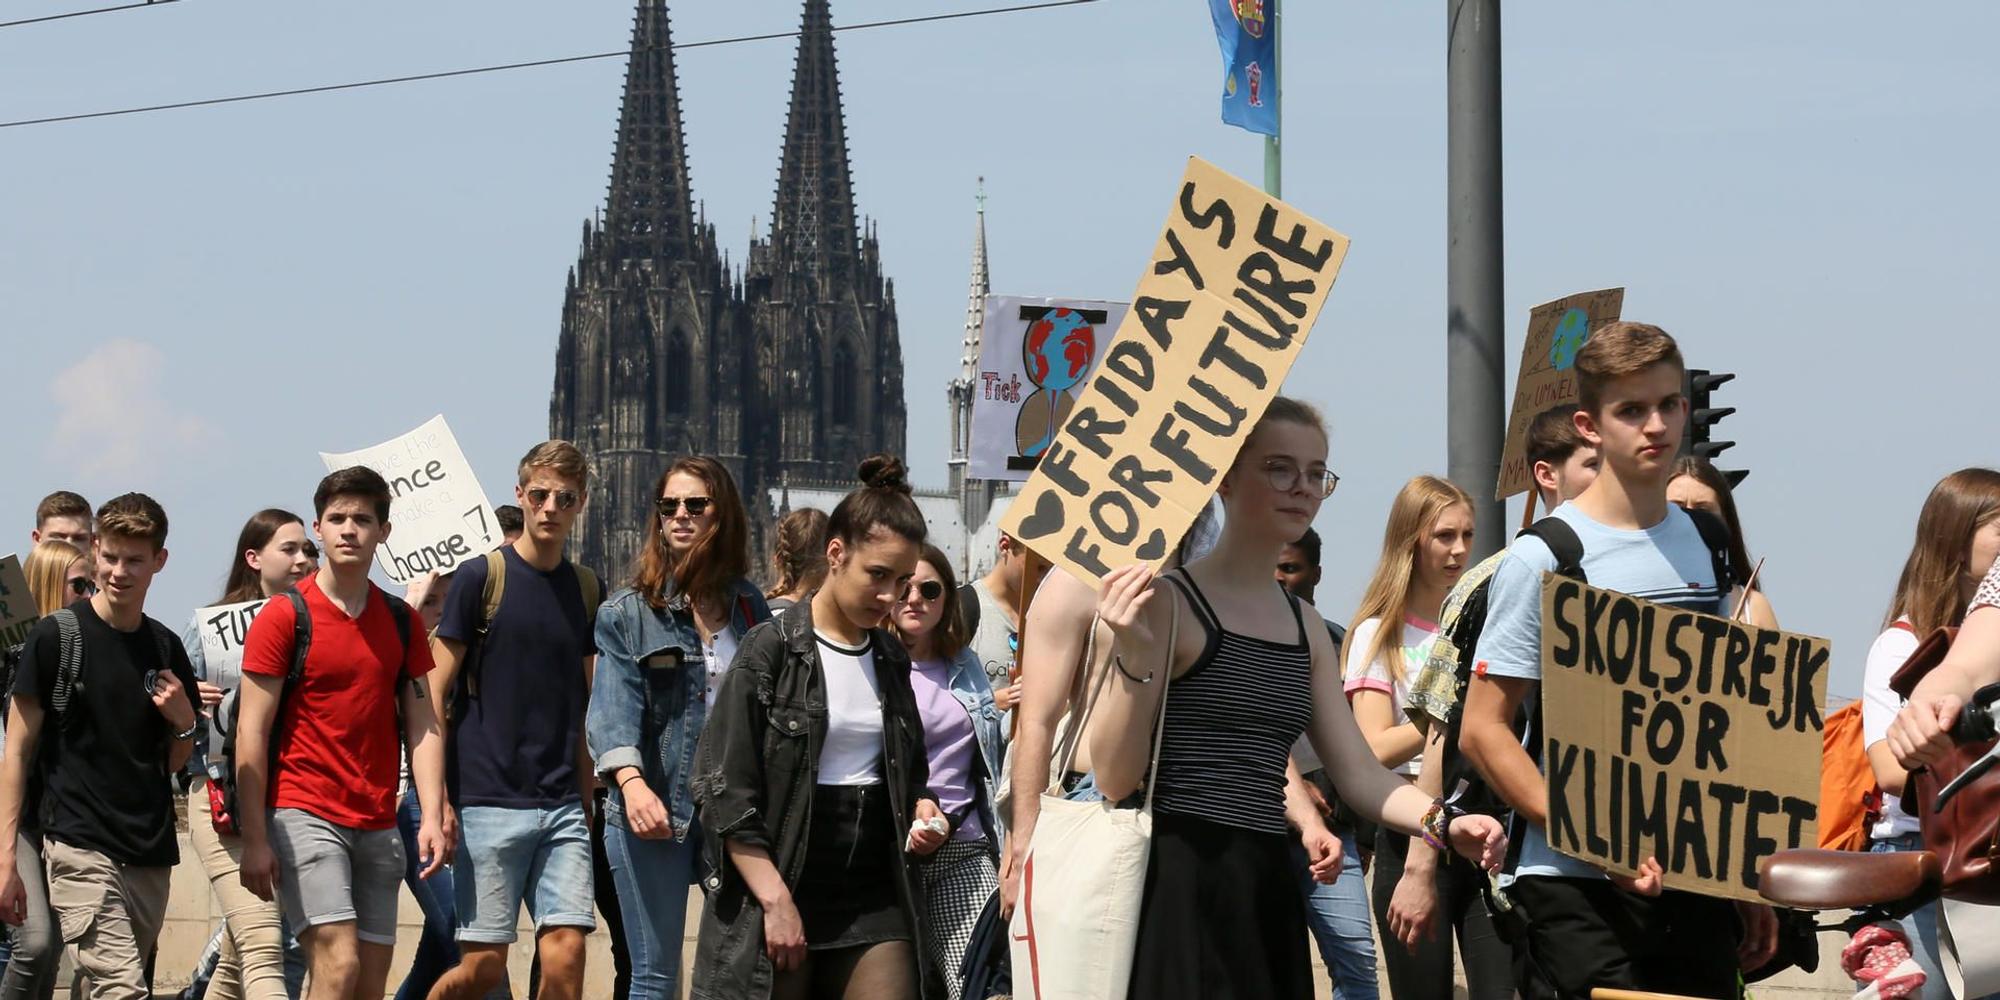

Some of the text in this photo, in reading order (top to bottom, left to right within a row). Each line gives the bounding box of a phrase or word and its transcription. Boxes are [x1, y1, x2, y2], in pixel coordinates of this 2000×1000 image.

[1040, 181, 1236, 497] FRIDAYS
[1063, 203, 1334, 579] FOR FUTURE
[1534, 378, 1579, 407] UMWEL
[207, 602, 264, 651] FUT
[985, 660, 1010, 677] Cal
[1553, 581, 1829, 732] SKOLSTREJK
[1621, 688, 1730, 773] FÖR
[1550, 738, 1817, 890] KLIMATET
